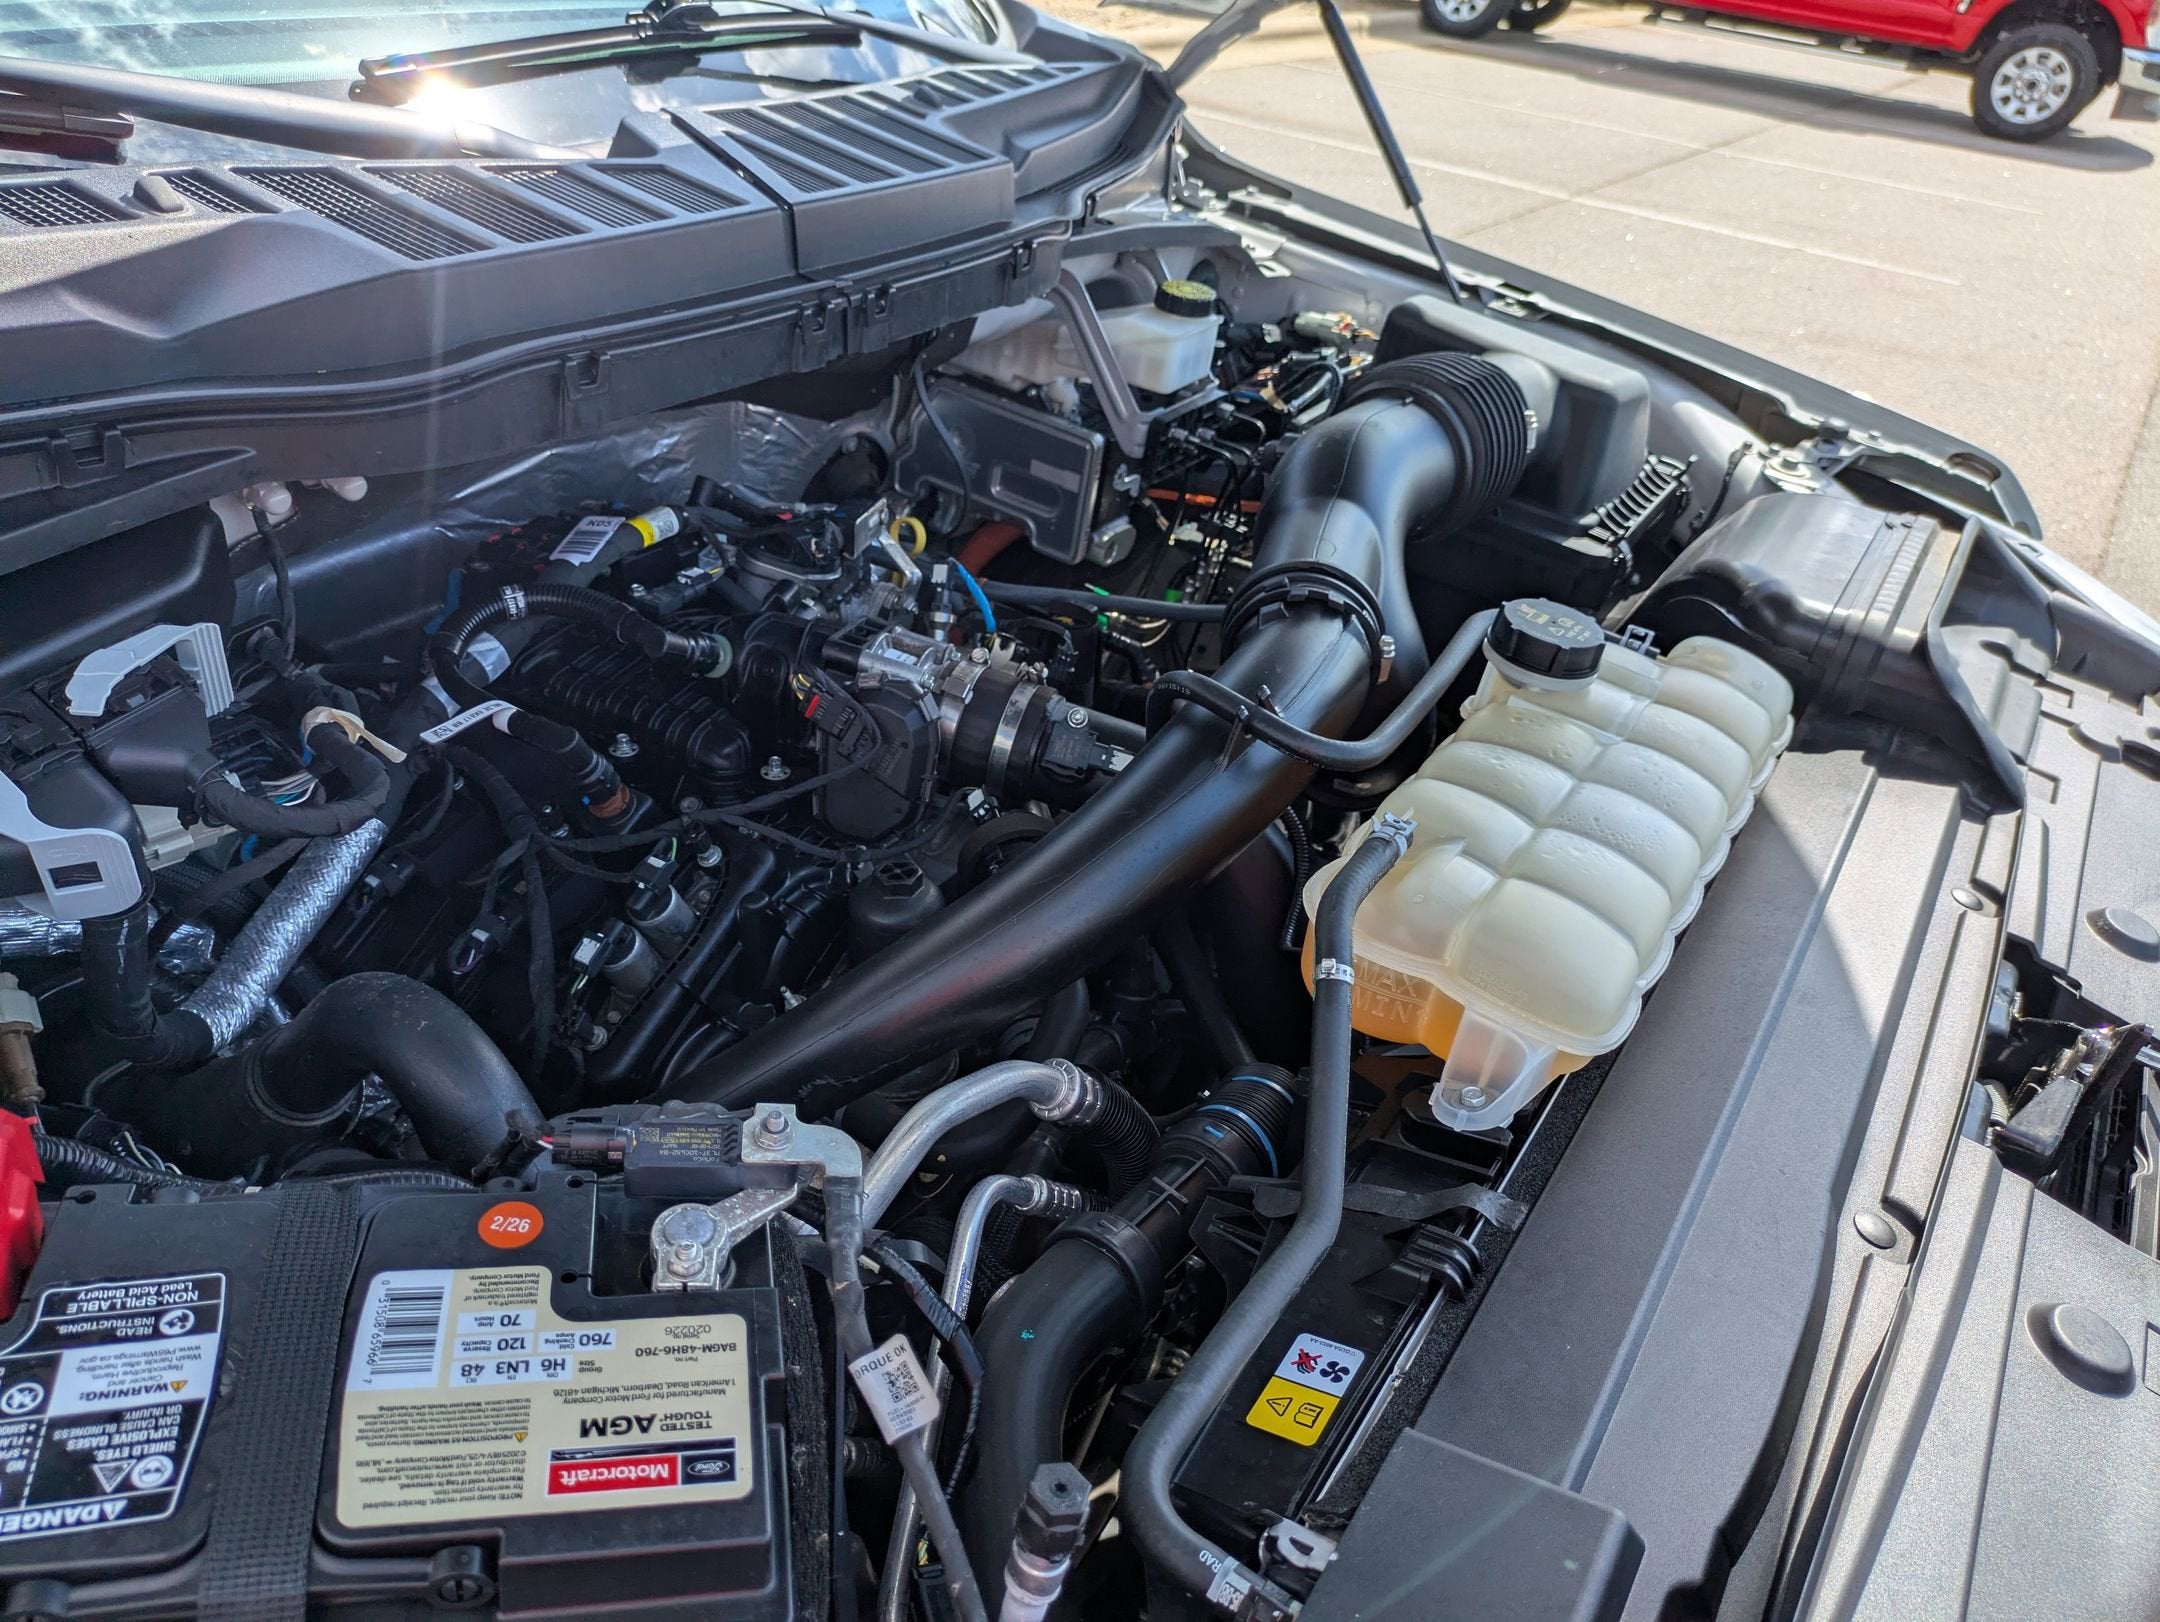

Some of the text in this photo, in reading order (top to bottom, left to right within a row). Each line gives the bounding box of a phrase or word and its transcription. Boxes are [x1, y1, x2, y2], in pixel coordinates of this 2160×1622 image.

[1353, 986, 1413, 1024] MIN
[490, 1215, 531, 1233] 2/26
[76, 1281, 192, 1300] Lead Acid Battery
[506, 1291, 538, 1299] registered
[66, 1290, 198, 1313] NON-SPILLABLE
[373, 1298, 388, 1328] 31508
[54, 1316, 154, 1334] INSTRUCTIONS.
[500, 1314, 521, 1326] 70
[116, 1326, 152, 1336] READ
[664, 1324, 711, 1335] 020226
[497, 1336, 526, 1350] 120
[578, 1332, 611, 1346] 760
[80, 1344, 201, 1364] www.P65Warnings.ca.gov
[366, 1332, 380, 1365] 65966
[634, 1342, 736, 1356] BAGM-48H6-760
[894, 1343, 907, 1357] OK
[144, 1356, 172, 1365] hands
[175, 1353, 201, 1362] Wash
[121, 1360, 141, 1368] after
[122, 1363, 183, 1376] Reproductive
[460, 1358, 565, 1377] H6 LN3 48
[107, 1374, 162, 1387] Cancer and
[664, 1381, 689, 1389] Road,
[690, 1379, 730, 1388] American
[78, 1382, 168, 1401] WARNING:
[552, 1387, 579, 1396] 48126
[580, 1385, 619, 1394] Michigan
[620, 1382, 663, 1392] Dearborn,
[562, 1388, 726, 1405] Manufactured for Ford Motor Company
[166, 1403, 182, 1414] OR
[52, 1414, 180, 1440] CAN CAUSE BLINDNESS
[579, 1413, 656, 1438] AGM
[660, 1420, 712, 1431] TESTED
[66, 1425, 178, 1450] EXPLOSIVE GASES
[131, 1440, 176, 1456] SHIELD
[484, 1458, 526, 1467] distributor
[435, 1469, 471, 1478] warranty
[473, 1466, 511, 1476] complete
[512, 1466, 524, 1474] For
[560, 1461, 724, 1486] Ford Motorcraft
[445, 1478, 459, 1487] tag
[460, 1478, 466, 1486] if
[467, 1477, 485, 1485] void
[486, 1475, 524, 1484] Warranty
[476, 1484, 511, 1493] warranty
[476, 1493, 496, 1501] Keep
[498, 1492, 522, 1500] NOTE:
[362, 1499, 396, 1509] required
[397, 1498, 426, 1507] Receipt
[0, 1503, 100, 1534] DANGE
[1199, 1550, 1222, 1574] RAD
